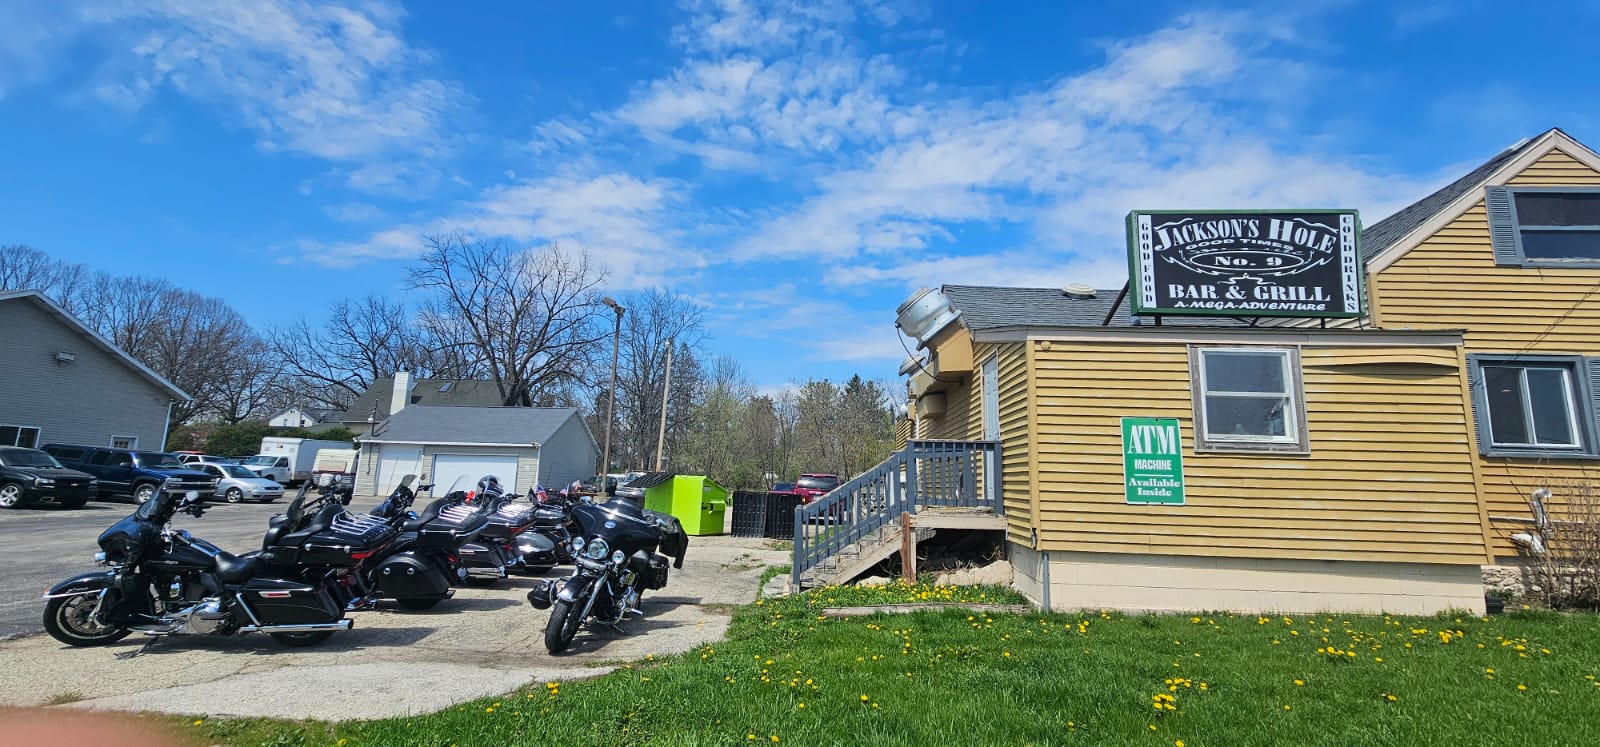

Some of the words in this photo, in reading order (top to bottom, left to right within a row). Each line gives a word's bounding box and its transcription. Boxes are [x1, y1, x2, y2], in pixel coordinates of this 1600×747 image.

[1141, 223, 1150, 260] GOOD
[1154, 218, 1260, 251] JACKSON'S
[1268, 218, 1337, 254] HOLE
[1185, 239, 1235, 250] GOOD
[1239, 238, 1295, 251] TIMES
[1342, 216, 1352, 252] COLD
[1214, 256, 1256, 266] No.
[1265, 257, 1283, 266] 9
[1144, 265, 1152, 302] FOOD
[1168, 284, 1220, 299] BAR
[1225, 284, 1247, 300] &
[1253, 285, 1331, 302] GRILL
[1344, 256, 1355, 310] DRINKS
[1128, 425, 1177, 455] ATM
[1134, 458, 1172, 470] MACHINE
[1129, 478, 1180, 487] Available
[1137, 487, 1172, 496] Inside
